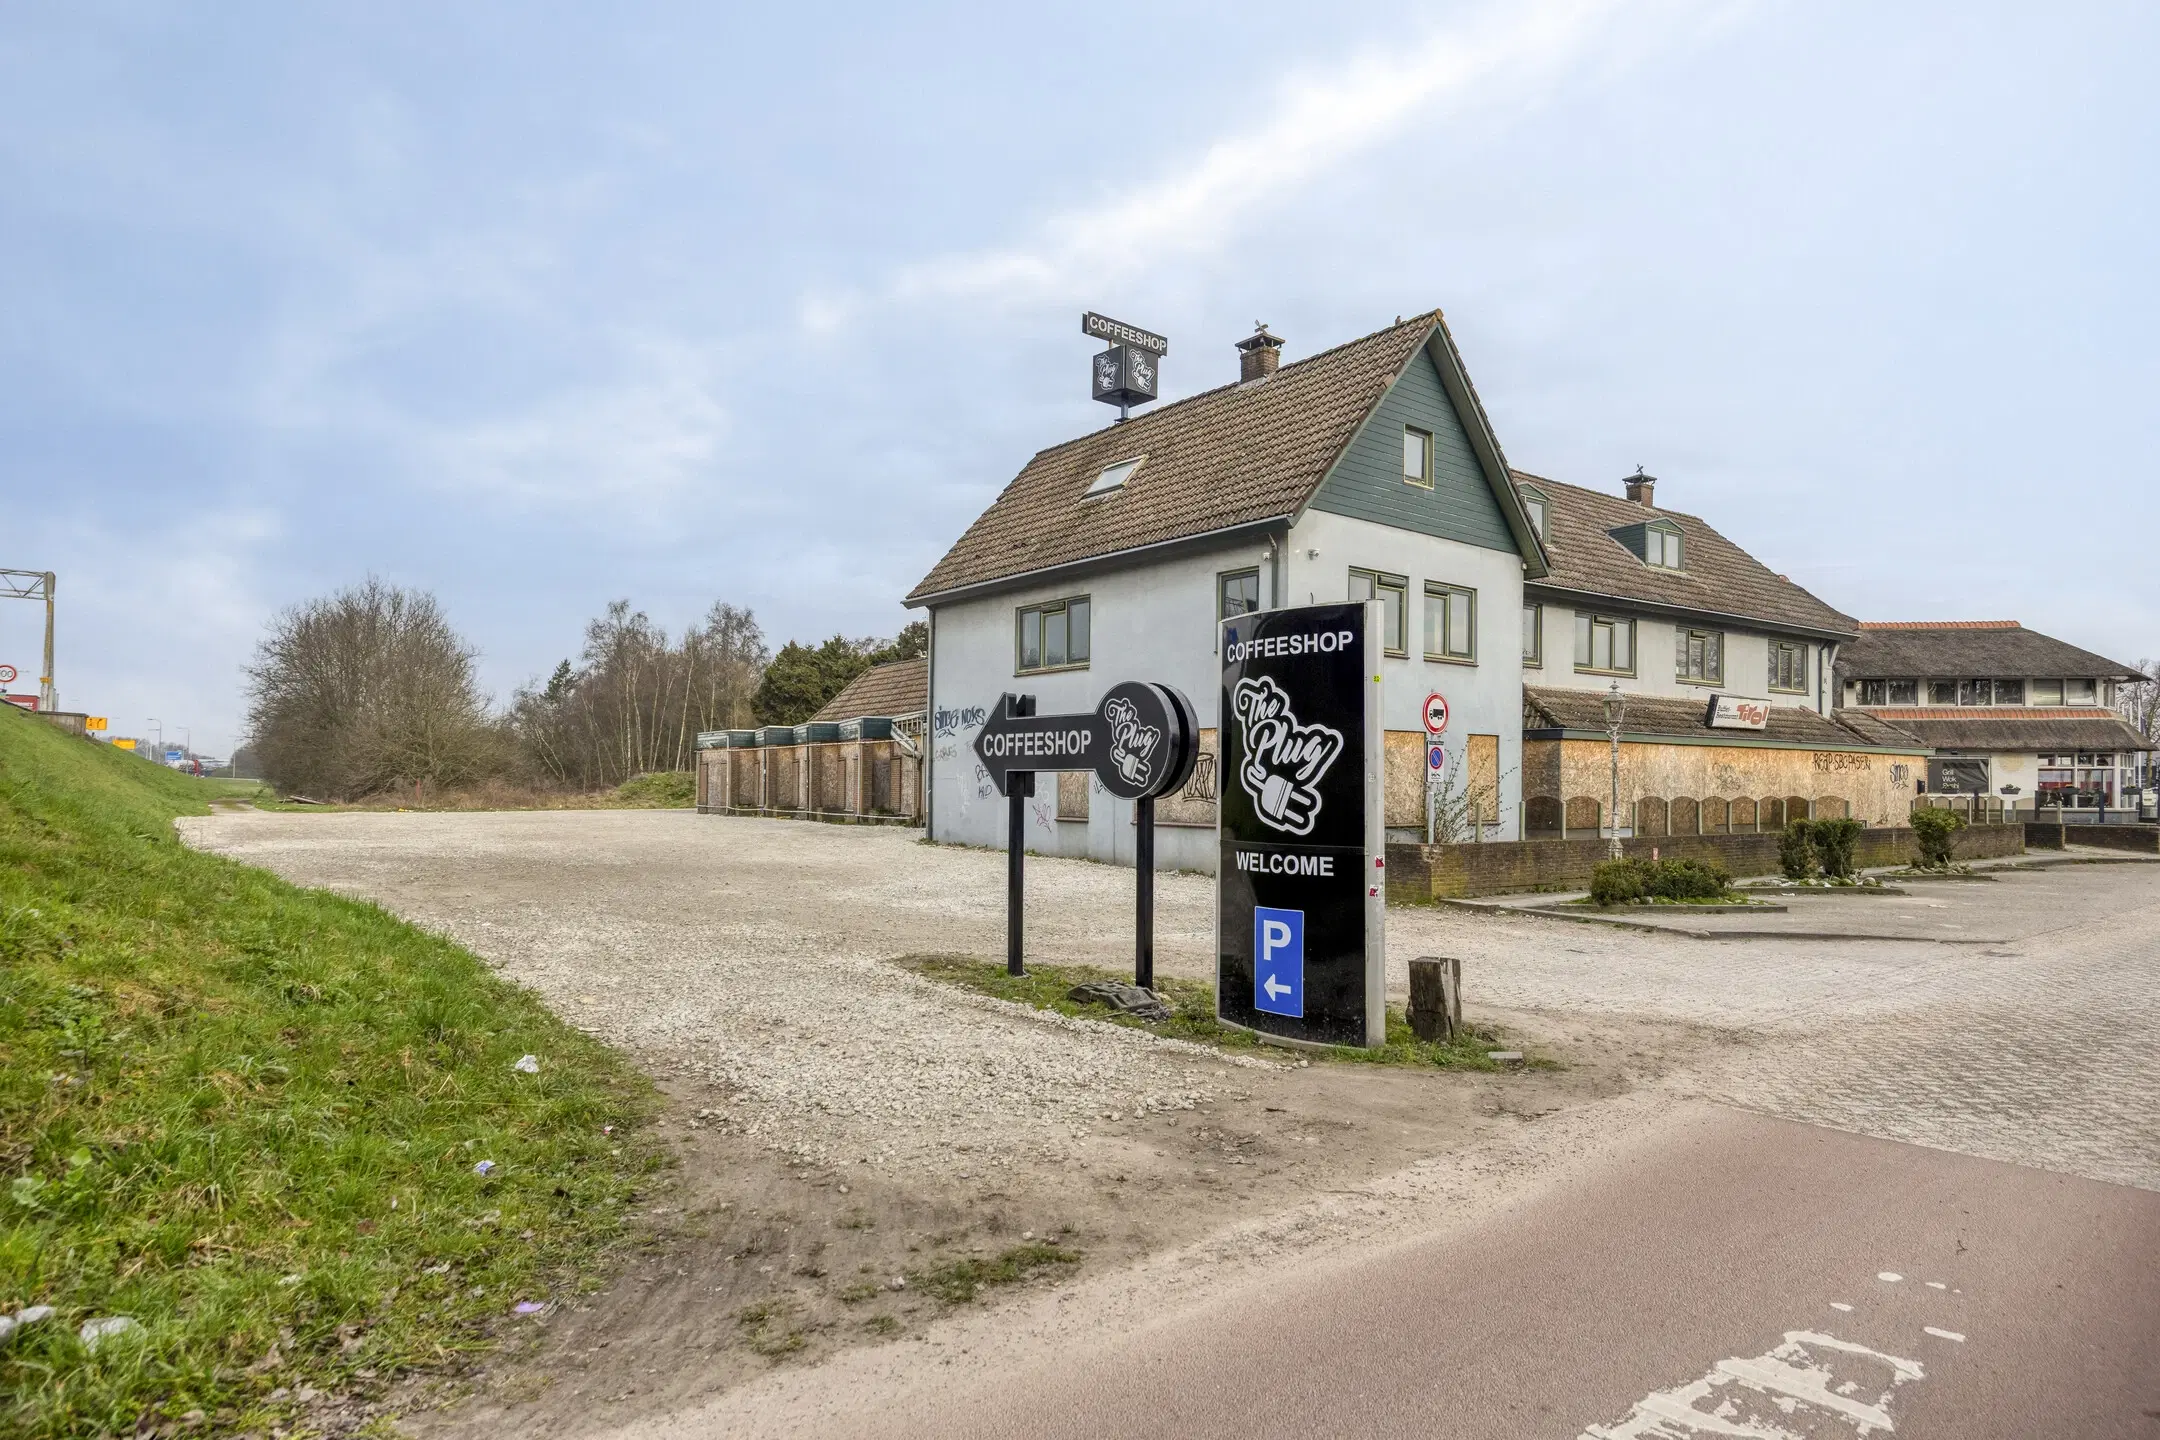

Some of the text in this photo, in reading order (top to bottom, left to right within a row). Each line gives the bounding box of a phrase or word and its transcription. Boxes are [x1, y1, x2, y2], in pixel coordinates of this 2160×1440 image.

[1089, 316, 1167, 351] COFFEESHOP
[1227, 631, 1354, 663] COFFEESHOP
[1108, 702, 1133, 726] The
[1238, 687, 1281, 727] The
[1736, 704, 1769, 725] Tirol
[983, 730, 1092, 757] COFFEESHOP
[1115, 721, 1158, 758] Plug
[1250, 718, 1333, 781] Plug
[1942, 775, 1957, 783] Wok
[1236, 851, 1335, 877] WELCOME
[1263, 919, 1292, 961] P
